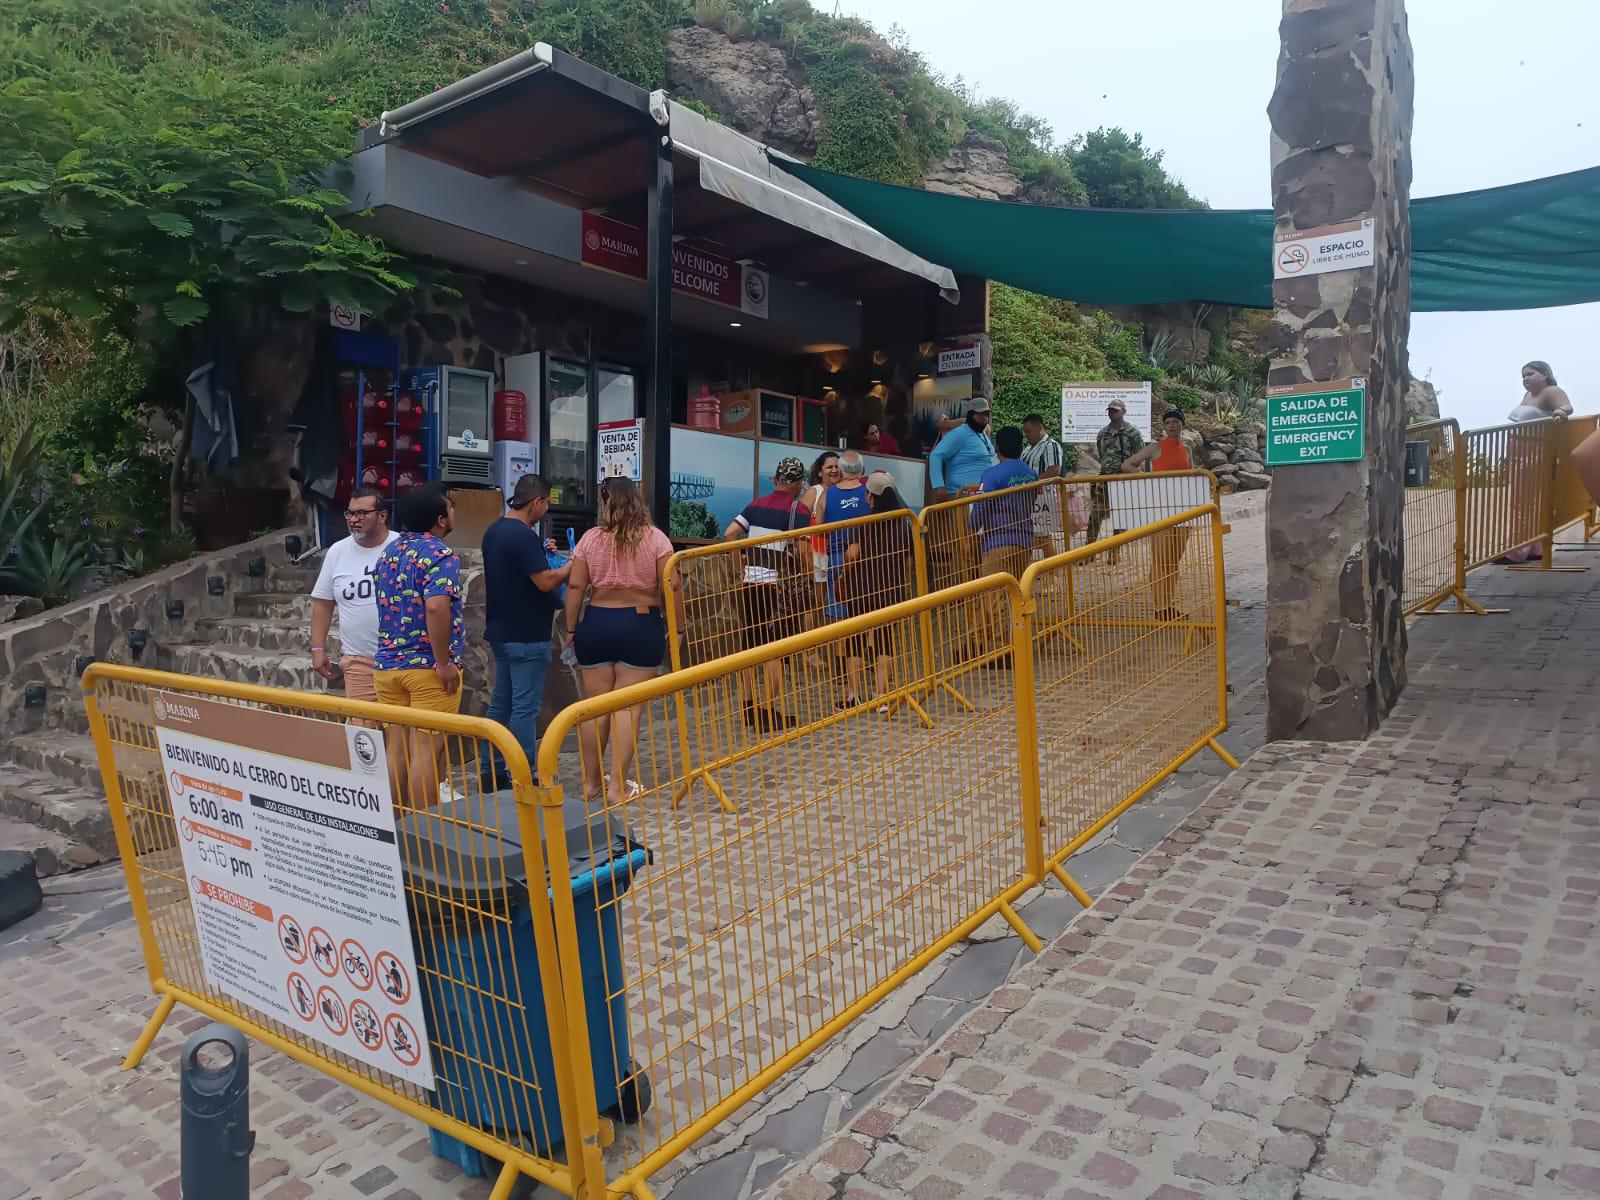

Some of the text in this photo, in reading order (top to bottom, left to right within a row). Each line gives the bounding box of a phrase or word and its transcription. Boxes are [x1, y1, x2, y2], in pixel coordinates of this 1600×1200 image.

[601, 236, 639, 256] MARINA
[1319, 240, 1364, 254] ESPACIO
[1346, 250, 1370, 259] HUMO
[671, 250, 729, 279] NVENIDOS
[671, 269, 720, 296] ELCOME
[941, 359, 976, 370] ENTRANCE
[942, 351, 976, 362] ENTRADA
[1074, 390, 1098, 399] ALTO
[1280, 396, 1348, 412] SALIDA DE
[1271, 410, 1358, 427] EMERGENCIA
[601, 431, 639, 444] VENTA DE
[1273, 429, 1356, 445] EMERGENCY
[604, 442, 636, 454] BEBIDAS
[1299, 445, 1328, 457] EXIT
[165, 702, 201, 720] MARINA
[165, 743, 380, 813] BIENVENIDO AL CERRO DEL CRESTÓN
[189, 794, 218, 821] 6:00
[221, 808, 244, 829] am
[264, 800, 277, 811] USO
[277, 803, 306, 819] GENERAL
[305, 811, 316, 821] DE
[315, 813, 328, 825] LAS
[327, 818, 380, 839] INSTALACIONES
[230, 856, 254, 879] pm
[206, 884, 218, 897] SE
[218, 889, 256, 914] PROHIBE
